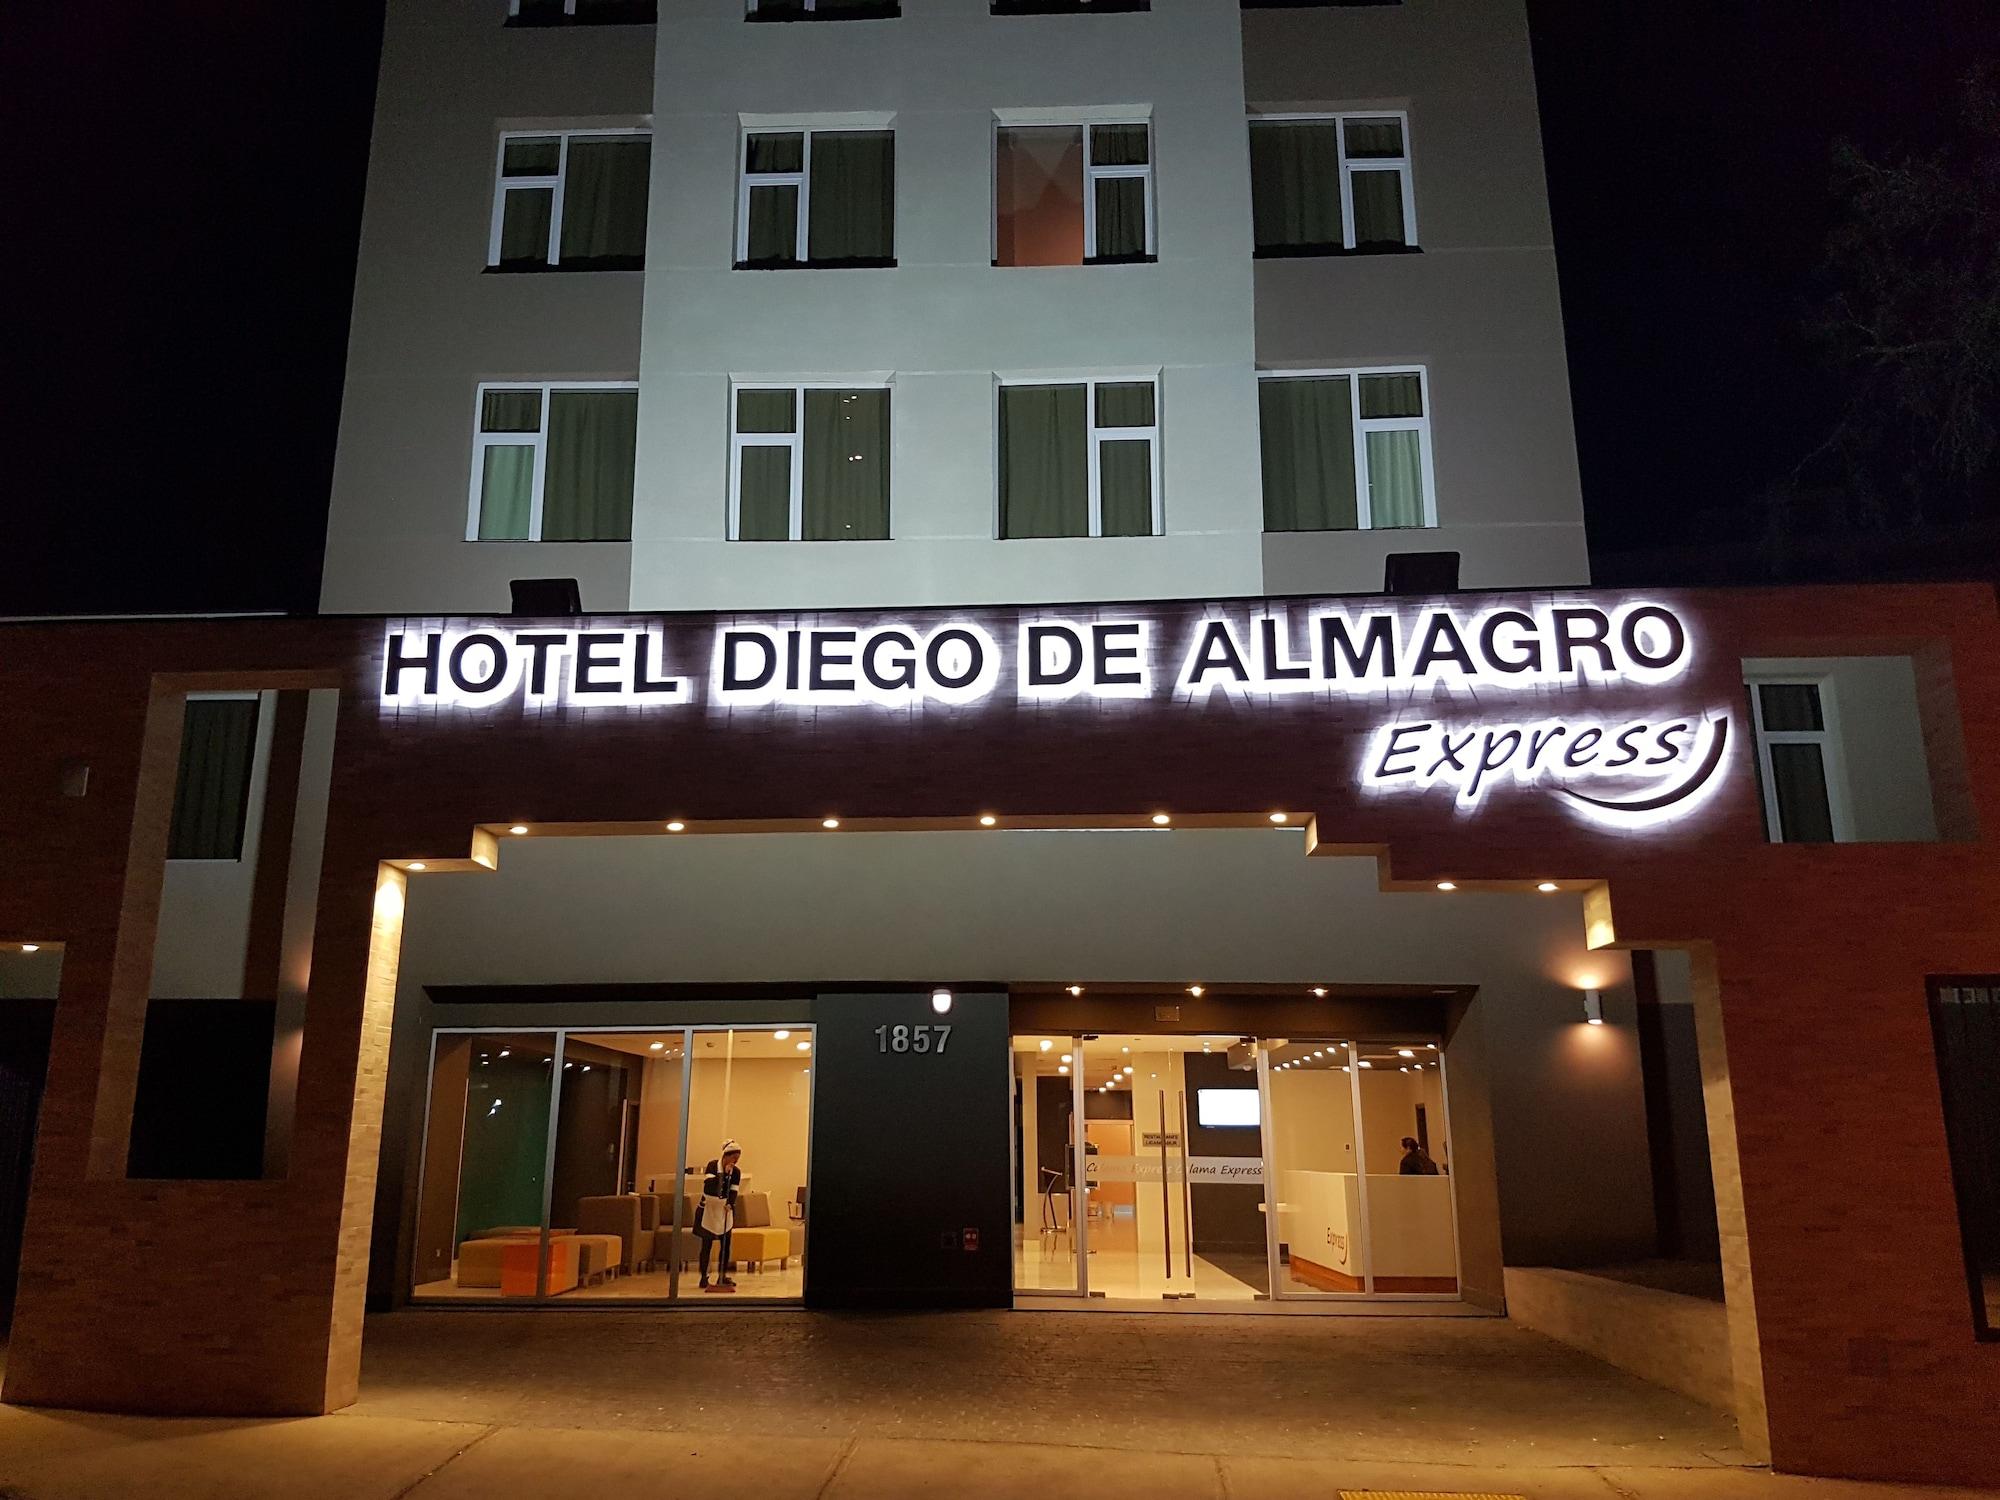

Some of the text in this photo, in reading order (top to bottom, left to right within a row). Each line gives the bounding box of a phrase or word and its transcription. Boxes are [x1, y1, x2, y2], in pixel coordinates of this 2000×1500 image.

[384, 605, 1686, 696] HOTEL DIEGO DE ALMAGRO
[1374, 721, 1682, 798] Express
[874, 1024, 952, 1054] 1857
[1220, 1164, 1262, 1178] Express
